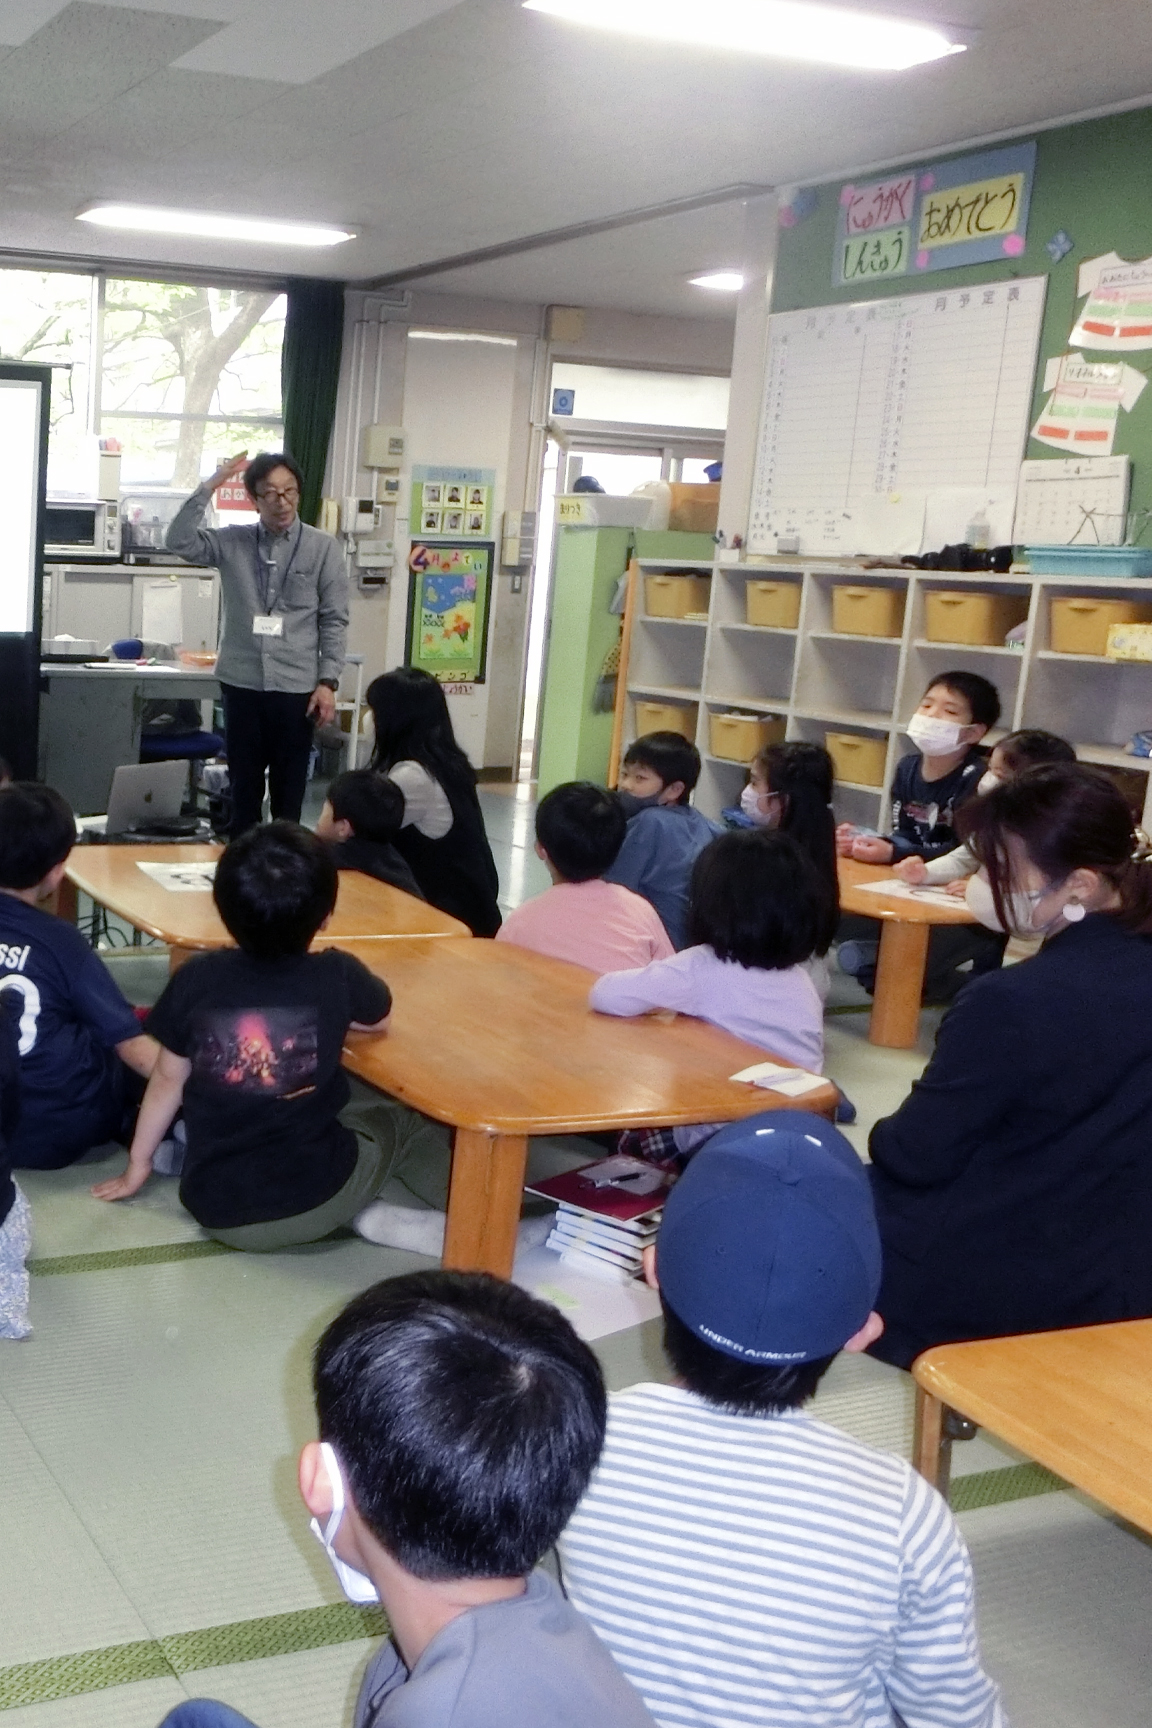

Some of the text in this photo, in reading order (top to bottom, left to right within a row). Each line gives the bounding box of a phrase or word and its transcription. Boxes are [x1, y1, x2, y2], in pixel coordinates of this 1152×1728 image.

[920, 182, 1016, 244] おめでとう
[843, 230, 904, 280] しんきゅう
[698, 1323, 807, 1360] UNDER ARMOUR
